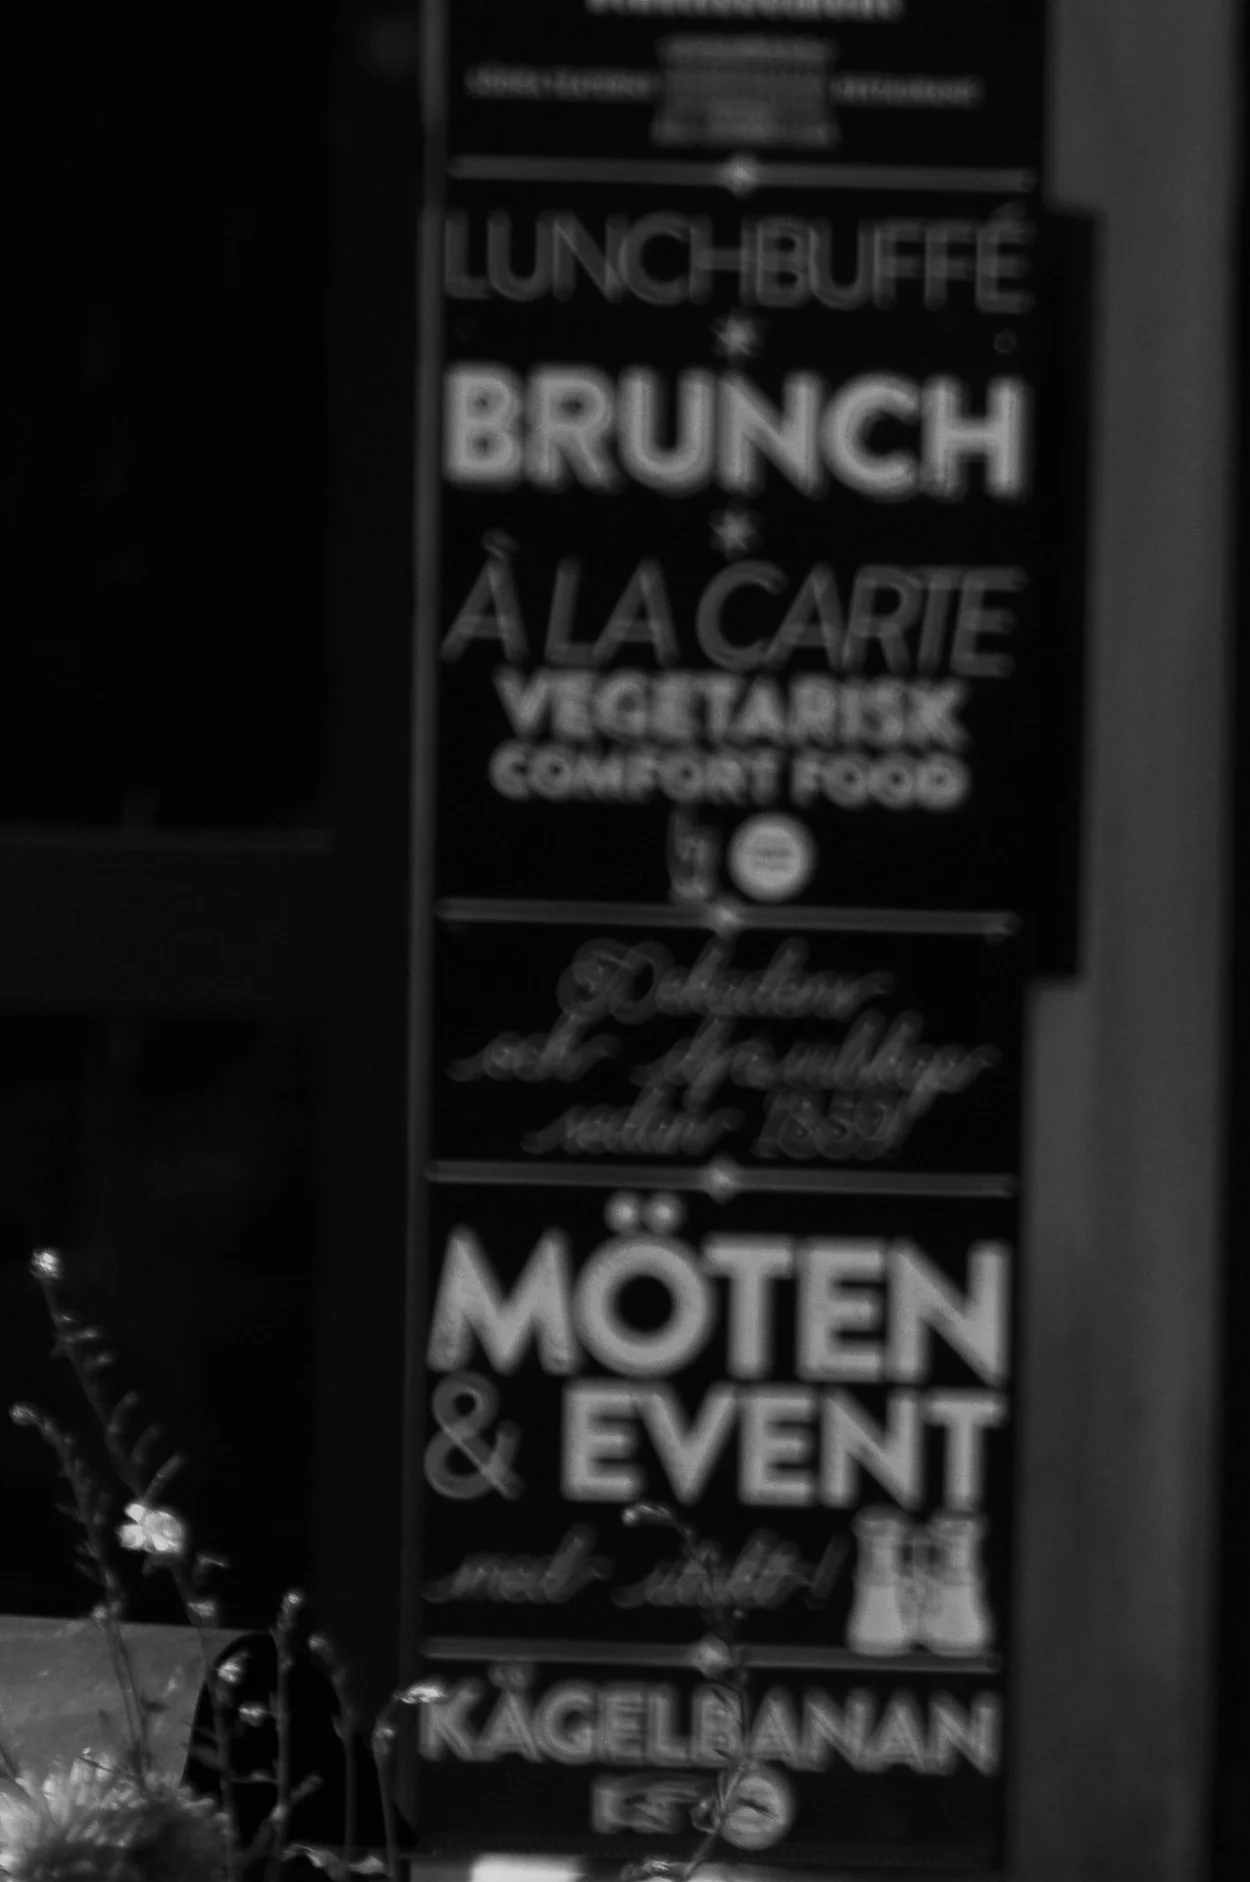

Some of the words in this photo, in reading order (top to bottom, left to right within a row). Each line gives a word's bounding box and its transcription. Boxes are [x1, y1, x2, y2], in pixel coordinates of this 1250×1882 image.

[446, 204, 1034, 311] LUNCHBUFFÉ
[446, 362, 1033, 501] BRUNCH
[442, 530, 527, 662] À
[544, 556, 680, 667] LA
[696, 559, 1027, 677] CARTE
[493, 666, 972, 749] VEGETARISK
[488, 739, 784, 805] COMFORT
[790, 748, 972, 810] FOOD
[428, 1190, 1013, 1384] MÖTEN
[425, 1370, 525, 1500] &
[560, 1377, 1008, 1509] EVENT
[418, 1660, 998, 1776] KÄGELBANAN
